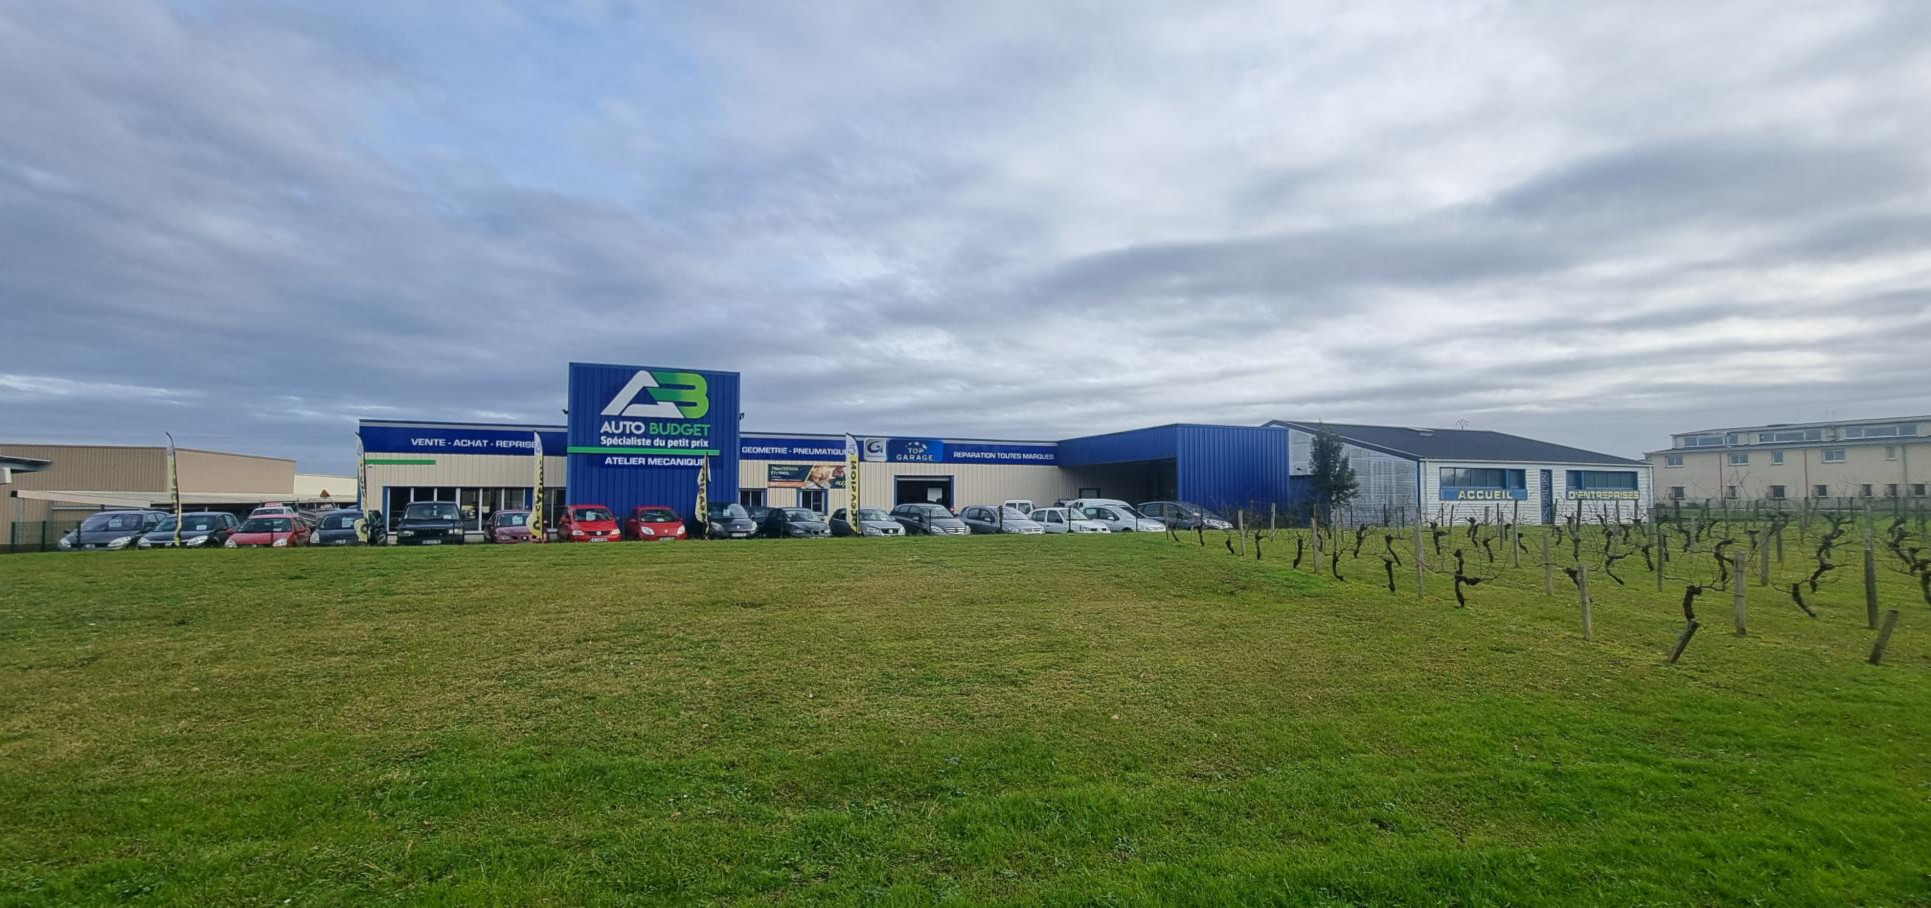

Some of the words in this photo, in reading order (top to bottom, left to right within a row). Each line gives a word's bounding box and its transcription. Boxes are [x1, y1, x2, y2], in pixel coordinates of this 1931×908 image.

[600, 421, 645, 434] AUTO
[649, 423, 711, 436] BUDGET
[411, 438, 446, 446] VENTE
[453, 439, 489, 448] ACHAT
[600, 435, 651, 447] Spécialiste
[653, 437, 665, 447] du
[667, 437, 689, 448] petit
[691, 438, 709, 449] prix
[741, 446, 788, 454] GEOMETRIE
[896, 454, 934, 462] GARAGE
[953, 451, 996, 459] REPARATION
[997, 452, 1022, 460] TOUTES
[604, 456, 646, 466] ATELIER
[1458, 490, 1513, 499] ACCUEIL
[1568, 491, 1640, 500] D'ENTREPRISES
